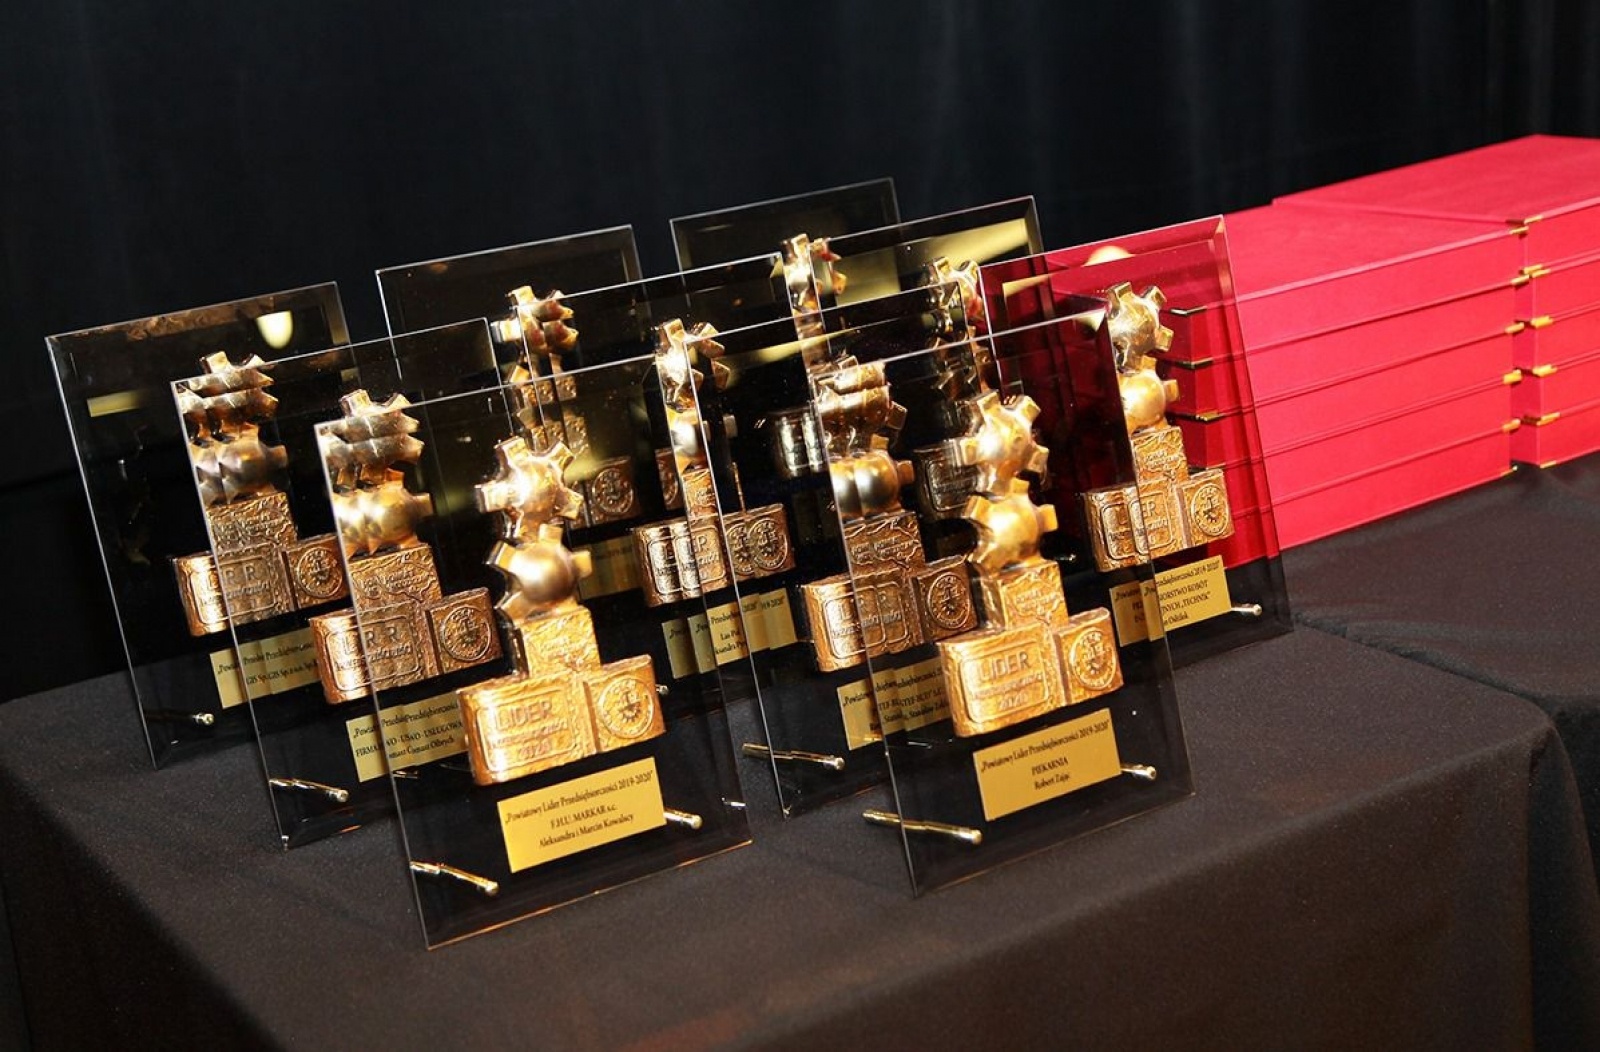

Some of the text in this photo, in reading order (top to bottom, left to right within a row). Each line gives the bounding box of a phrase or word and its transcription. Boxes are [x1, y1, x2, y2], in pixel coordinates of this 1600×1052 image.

[979, 651, 1029, 681] LIDER
[497, 700, 554, 730] LIDER
[540, 829, 575, 847] Aleksandra
[580, 822, 602, 837] Marcin
